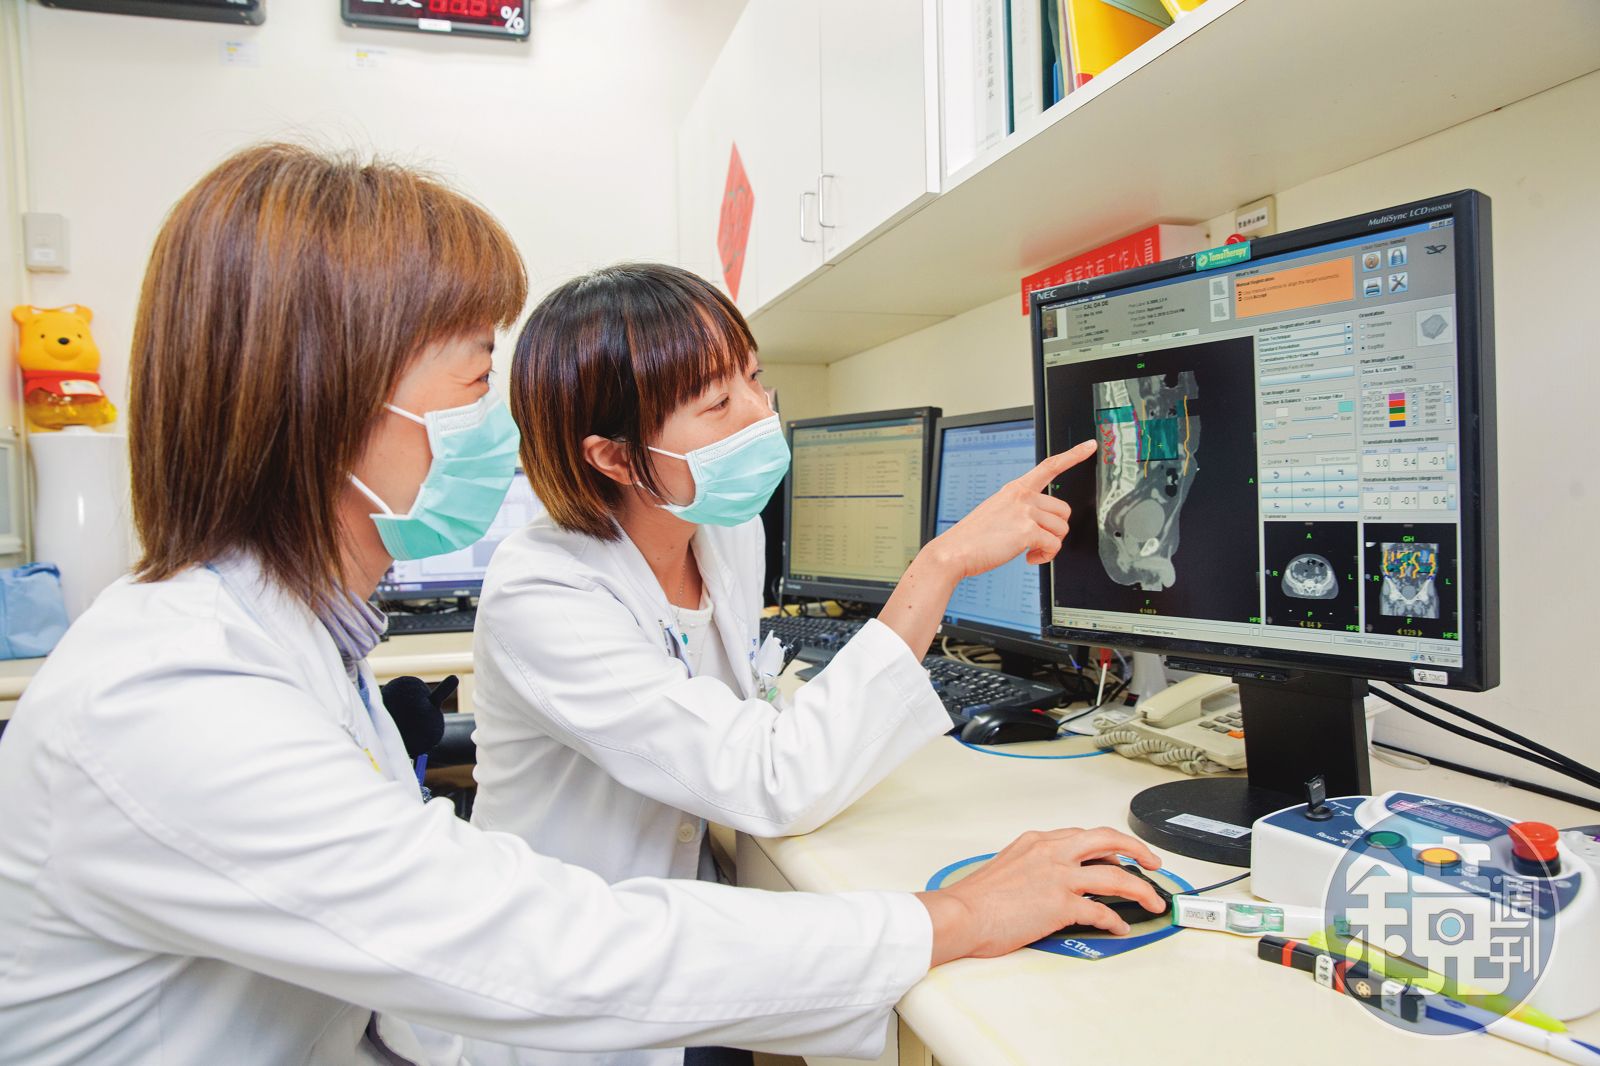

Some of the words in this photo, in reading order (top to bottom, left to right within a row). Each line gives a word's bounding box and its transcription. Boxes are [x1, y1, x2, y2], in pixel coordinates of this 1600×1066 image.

[1368, 212, 1408, 226] MultiSync
[1209, 246, 1248, 262] TomoTherapy
[1036, 289, 1058, 300] NEC
[1376, 459, 1388, 468] 3.0
[1403, 458, 1416, 467] 5.4
[1428, 456, 1445, 465] -0.1
[1373, 497, 1389, 506] -0.0
[1401, 496, 1416, 505] -0.1
[1432, 496, 1447, 505] 0.4
[1316, 832, 1340, 842] READY
[1064, 939, 1102, 957] CTrue
